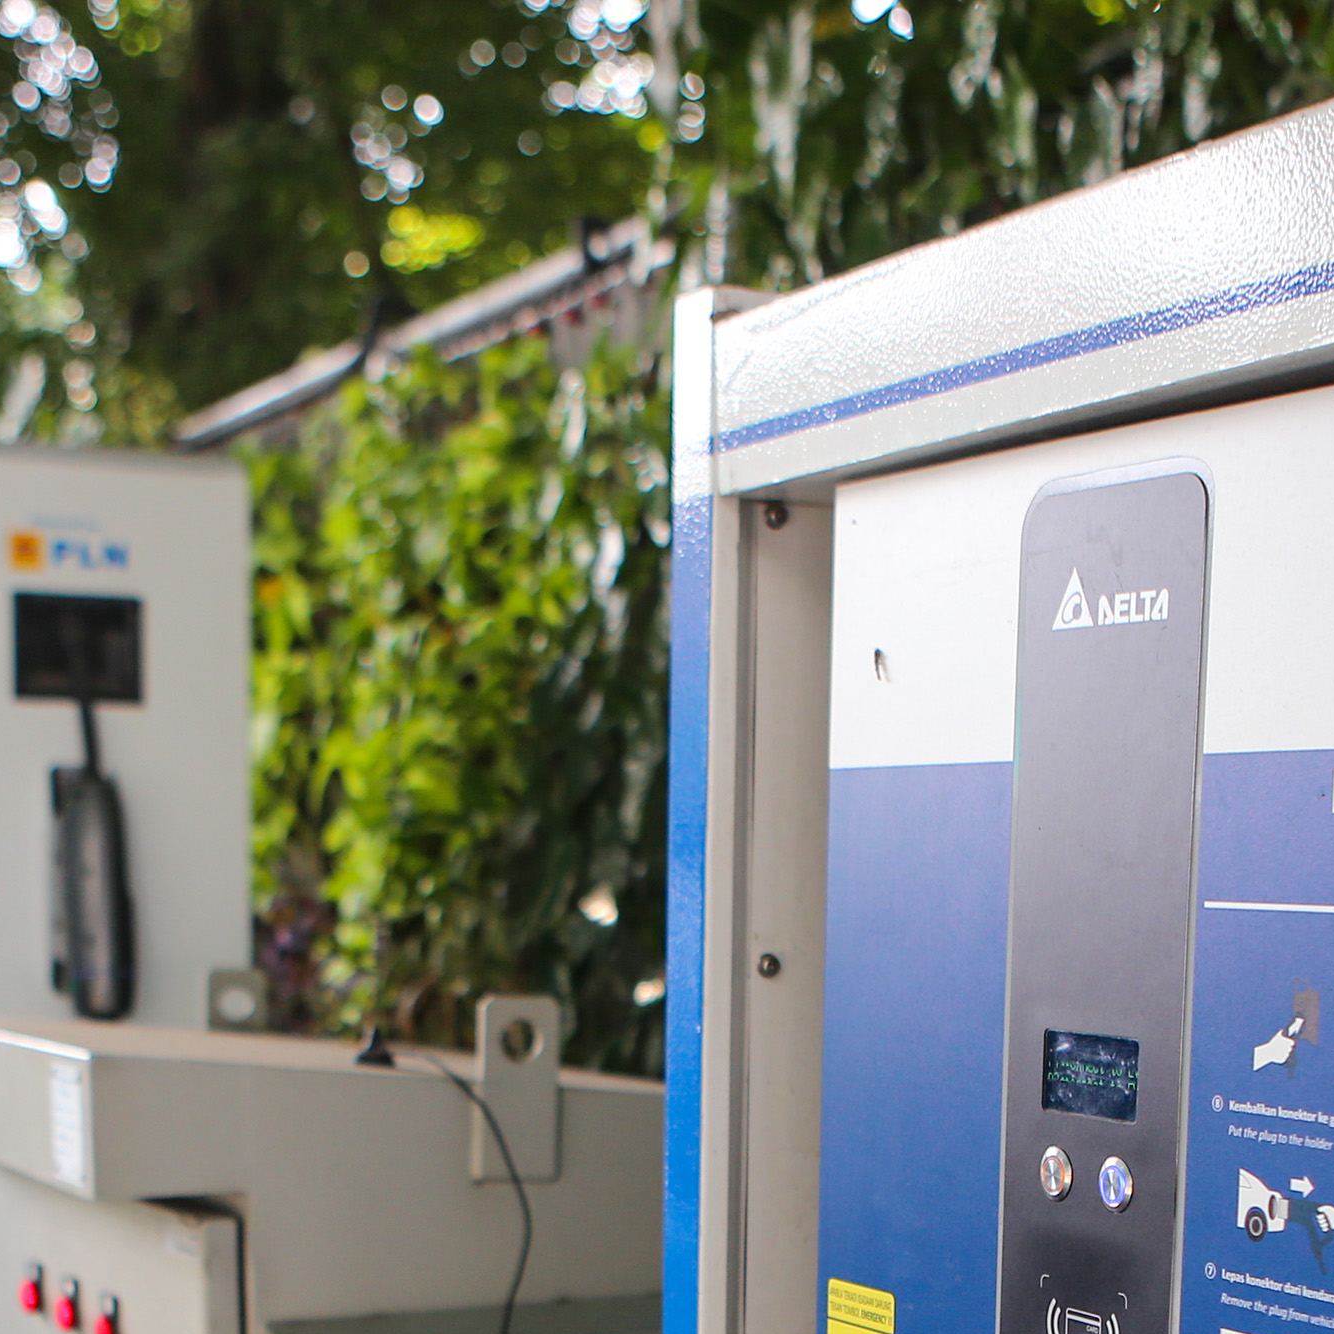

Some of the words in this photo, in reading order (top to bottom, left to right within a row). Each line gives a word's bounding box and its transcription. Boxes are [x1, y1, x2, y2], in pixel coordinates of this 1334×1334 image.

[52, 541, 129, 569] PLN
[1097, 587, 1169, 626] DELTA
[1229, 1100, 1276, 1116] Kembalikan
[1278, 1106, 1316, 1122] konektor
[1318, 1112, 1328, 1124] ke
[1228, 1125, 1242, 1137] Put
[1244, 1127, 1257, 1139] the
[1258, 1130, 1276, 1145] plug
[1278, 1132, 1287, 1144] to
[1289, 1134, 1303, 1147] the
[1305, 1136, 1334, 1150] holder
[1222, 1269, 1245, 1284] Lepas
[1246, 1273, 1283, 1292] konektor
[1284, 1282, 1301, 1296] dari
[1221, 1293, 1252, 1311] Remove
[1254, 1300, 1267, 1314] the
[1269, 1304, 1287, 1320] plug
[1287, 1307, 1309, 1323] from
